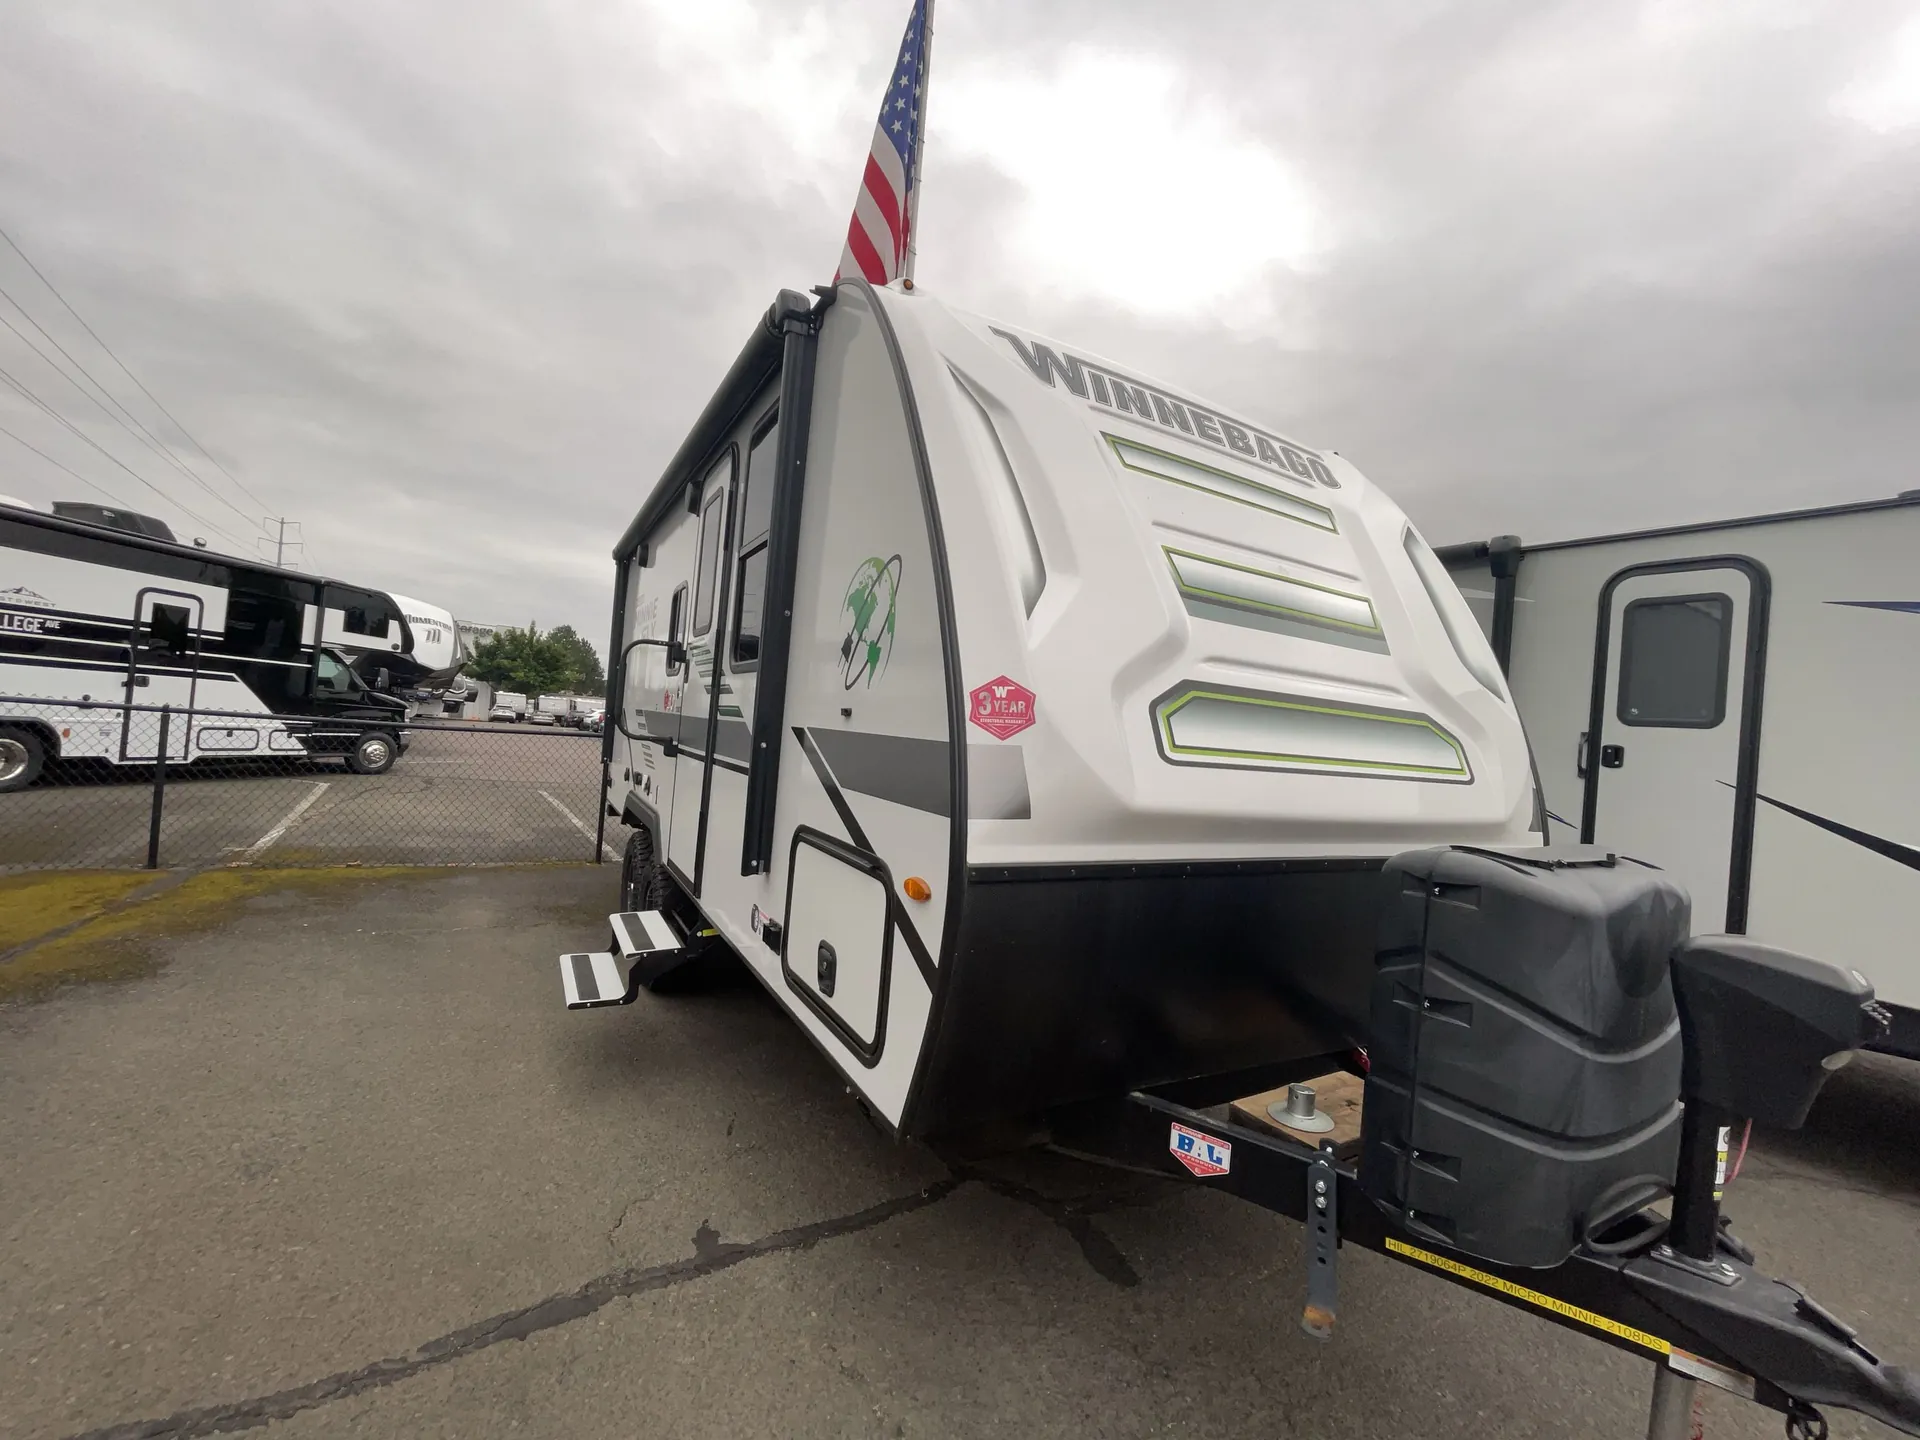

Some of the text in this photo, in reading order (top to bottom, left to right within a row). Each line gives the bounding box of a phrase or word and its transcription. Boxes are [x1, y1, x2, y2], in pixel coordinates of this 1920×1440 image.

[988, 325, 1341, 489] WINNEBAGO
[45, 620, 61, 629] AVE
[978, 691, 1026, 715] 3 YEAR
[1388, 1240, 1663, 1350] HIL 2719064P 2022 MICRO MINNIE 2108DS
